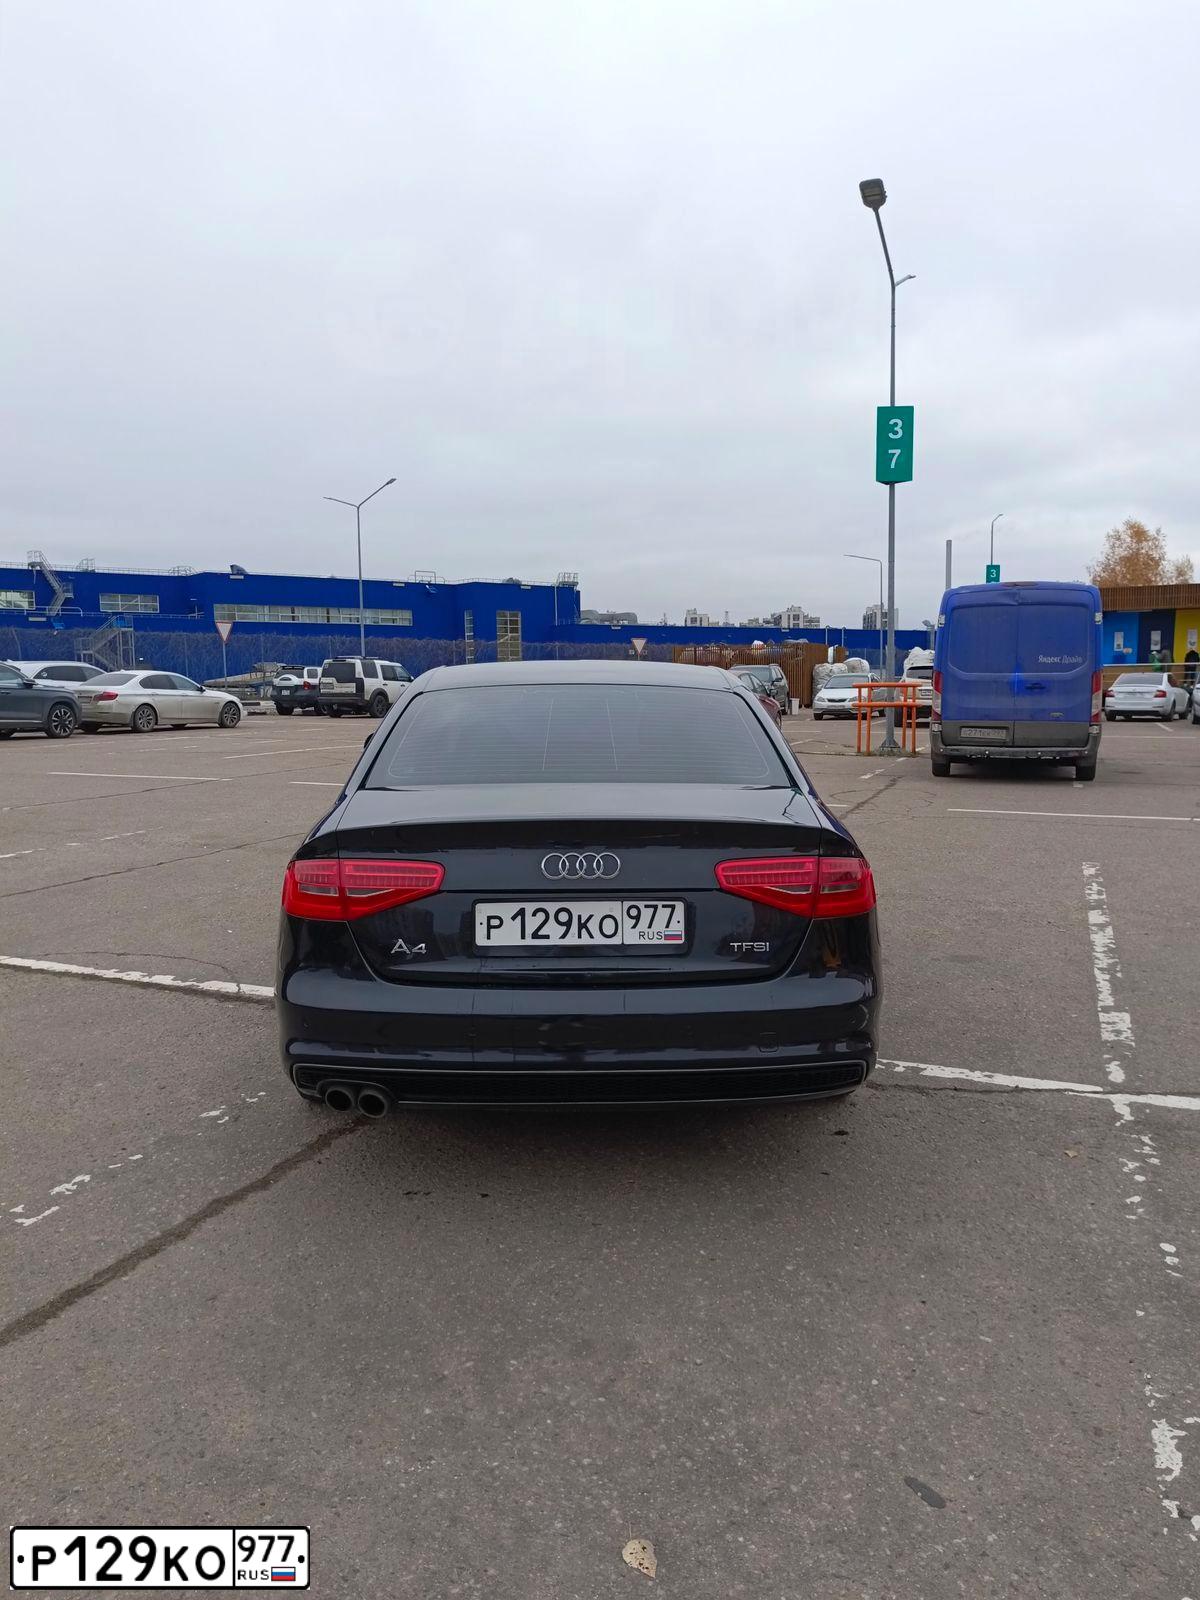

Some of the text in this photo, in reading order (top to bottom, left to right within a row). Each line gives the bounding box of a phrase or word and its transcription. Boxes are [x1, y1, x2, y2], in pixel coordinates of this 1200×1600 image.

[888, 418, 903, 439] 3
[888, 448, 901, 469] 7
[990, 569, 997, 578] 3
[1038, 654, 1061, 664] Яндекс
[626, 904, 676, 929] 977
[638, 930, 663, 941] RUS
[390, 938, 427, 954] A4
[730, 942, 769, 952] TFSI
